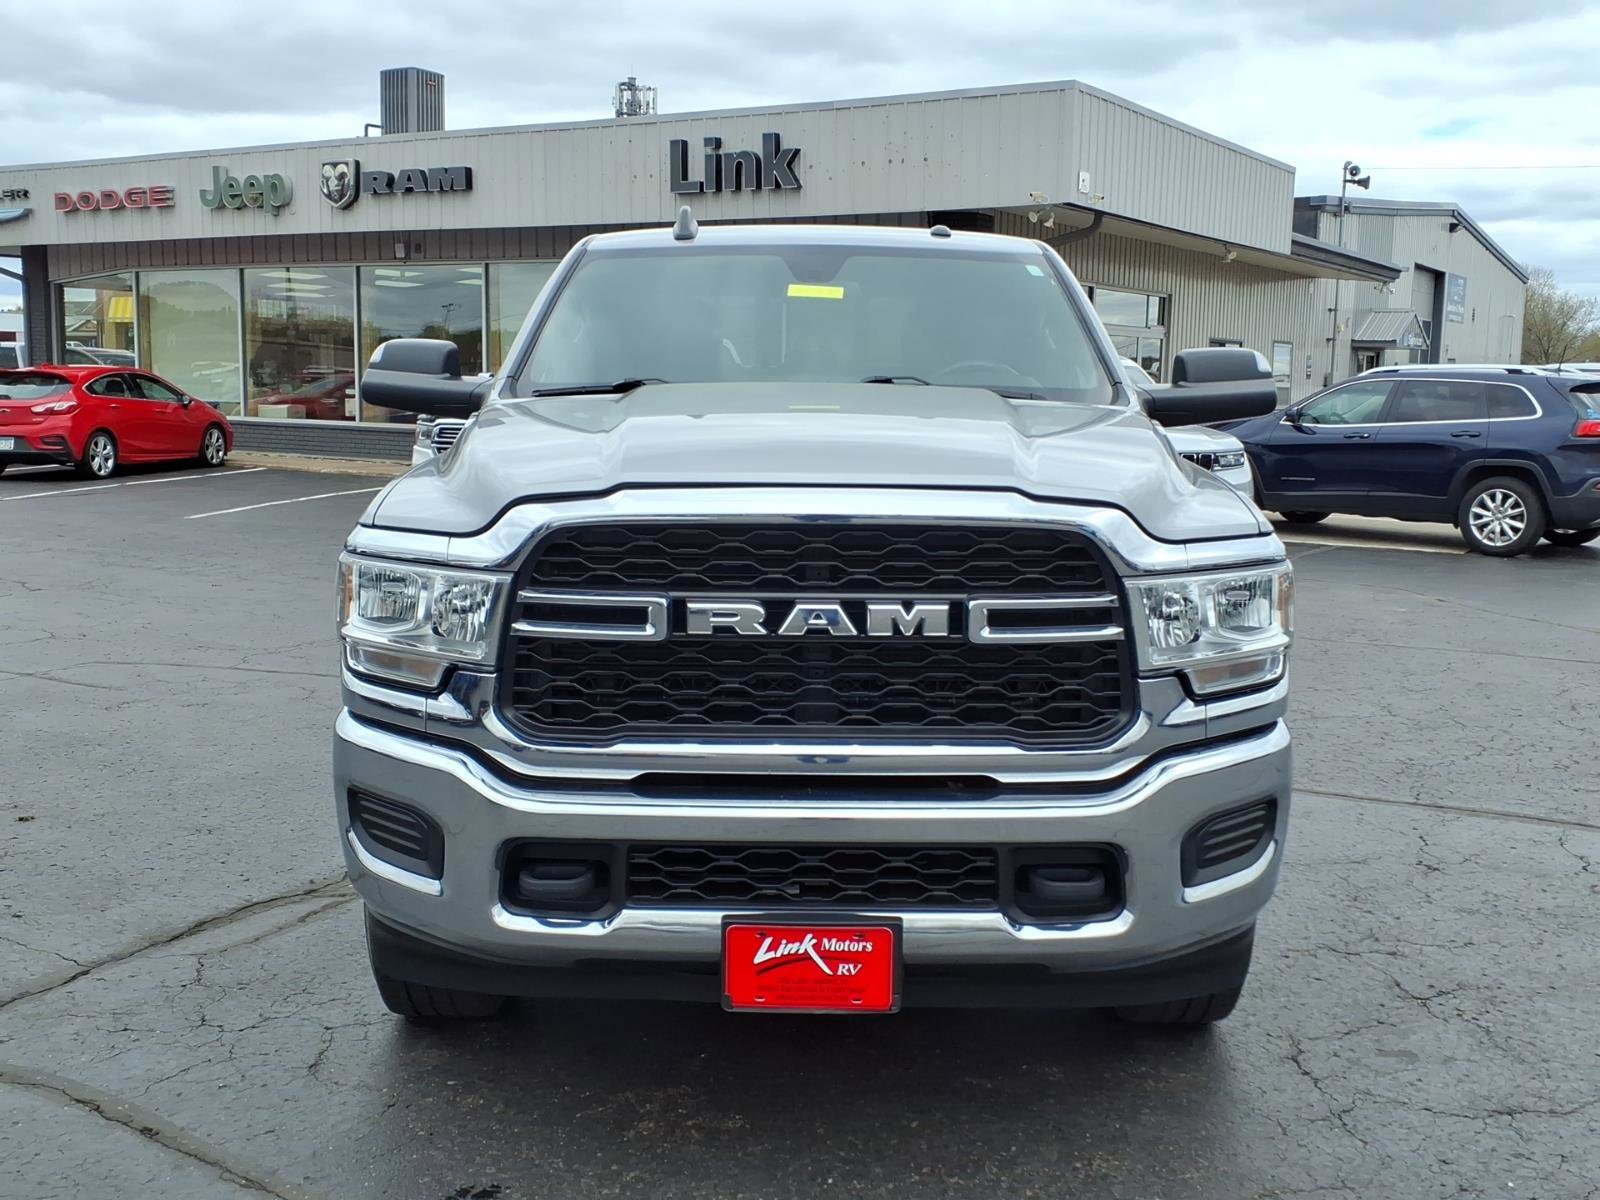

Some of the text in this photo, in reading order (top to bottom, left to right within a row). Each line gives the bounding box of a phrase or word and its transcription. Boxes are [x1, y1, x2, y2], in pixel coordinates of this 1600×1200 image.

[362, 166, 473, 195] RAM
[670, 132, 802, 193] Link
[54, 185, 175, 213] DODGE
[200, 165, 293, 216] Jeep
[686, 599, 950, 636] RAM
[753, 933, 873, 976] Link Motors
[836, 963, 863, 976] RV
